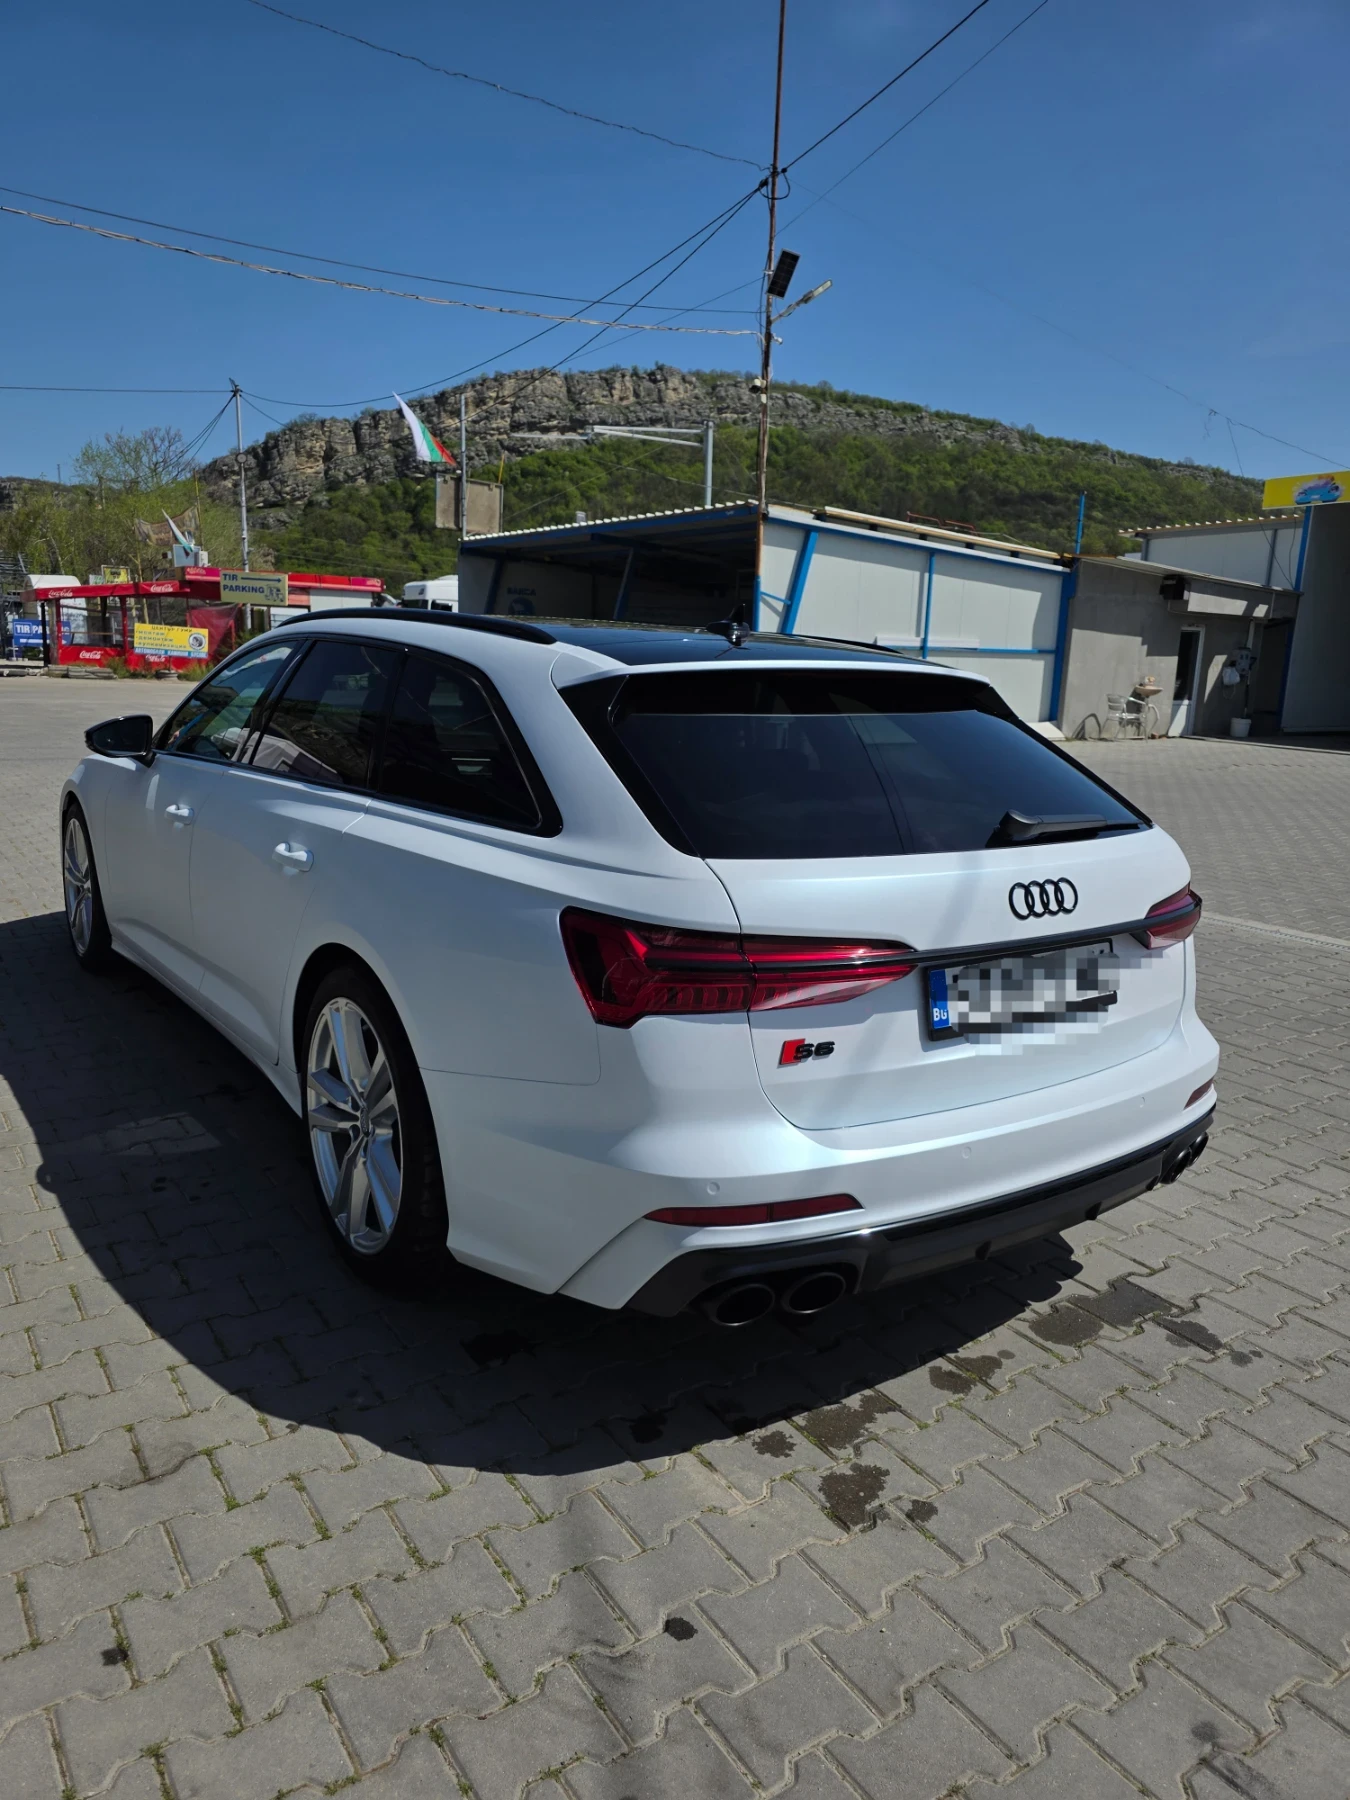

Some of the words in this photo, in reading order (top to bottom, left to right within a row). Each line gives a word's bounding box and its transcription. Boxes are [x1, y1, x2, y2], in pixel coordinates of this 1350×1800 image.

[222, 573, 238, 582] TIR
[223, 584, 265, 593] PARKING
[15, 624, 31, 634] TIR
[792, 1040, 836, 1060] S6
